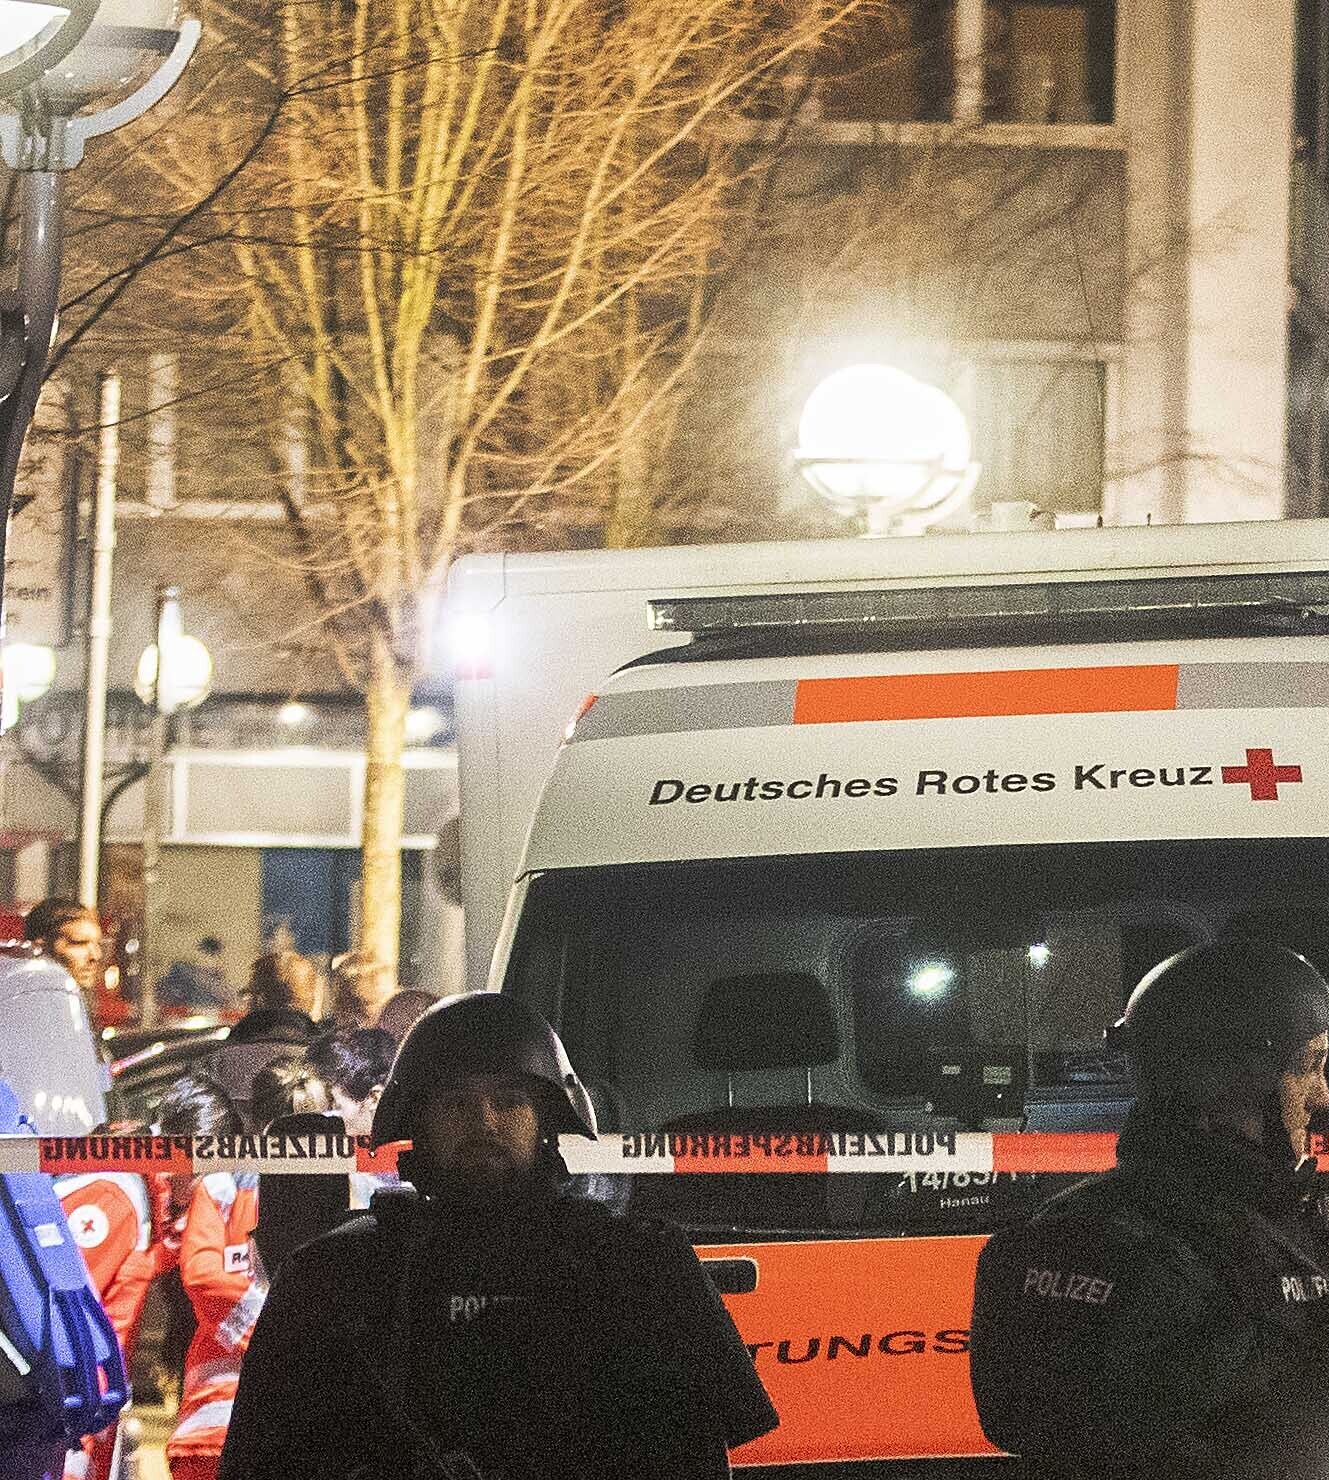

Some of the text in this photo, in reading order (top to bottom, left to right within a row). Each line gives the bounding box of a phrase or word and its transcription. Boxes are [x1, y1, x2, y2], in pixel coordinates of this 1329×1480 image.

[648, 762, 1213, 806] Deutsches Rotes Kreuz
[939, 1194, 991, 1210] Hanau
[1022, 1266, 1115, 1305] POLIZEI
